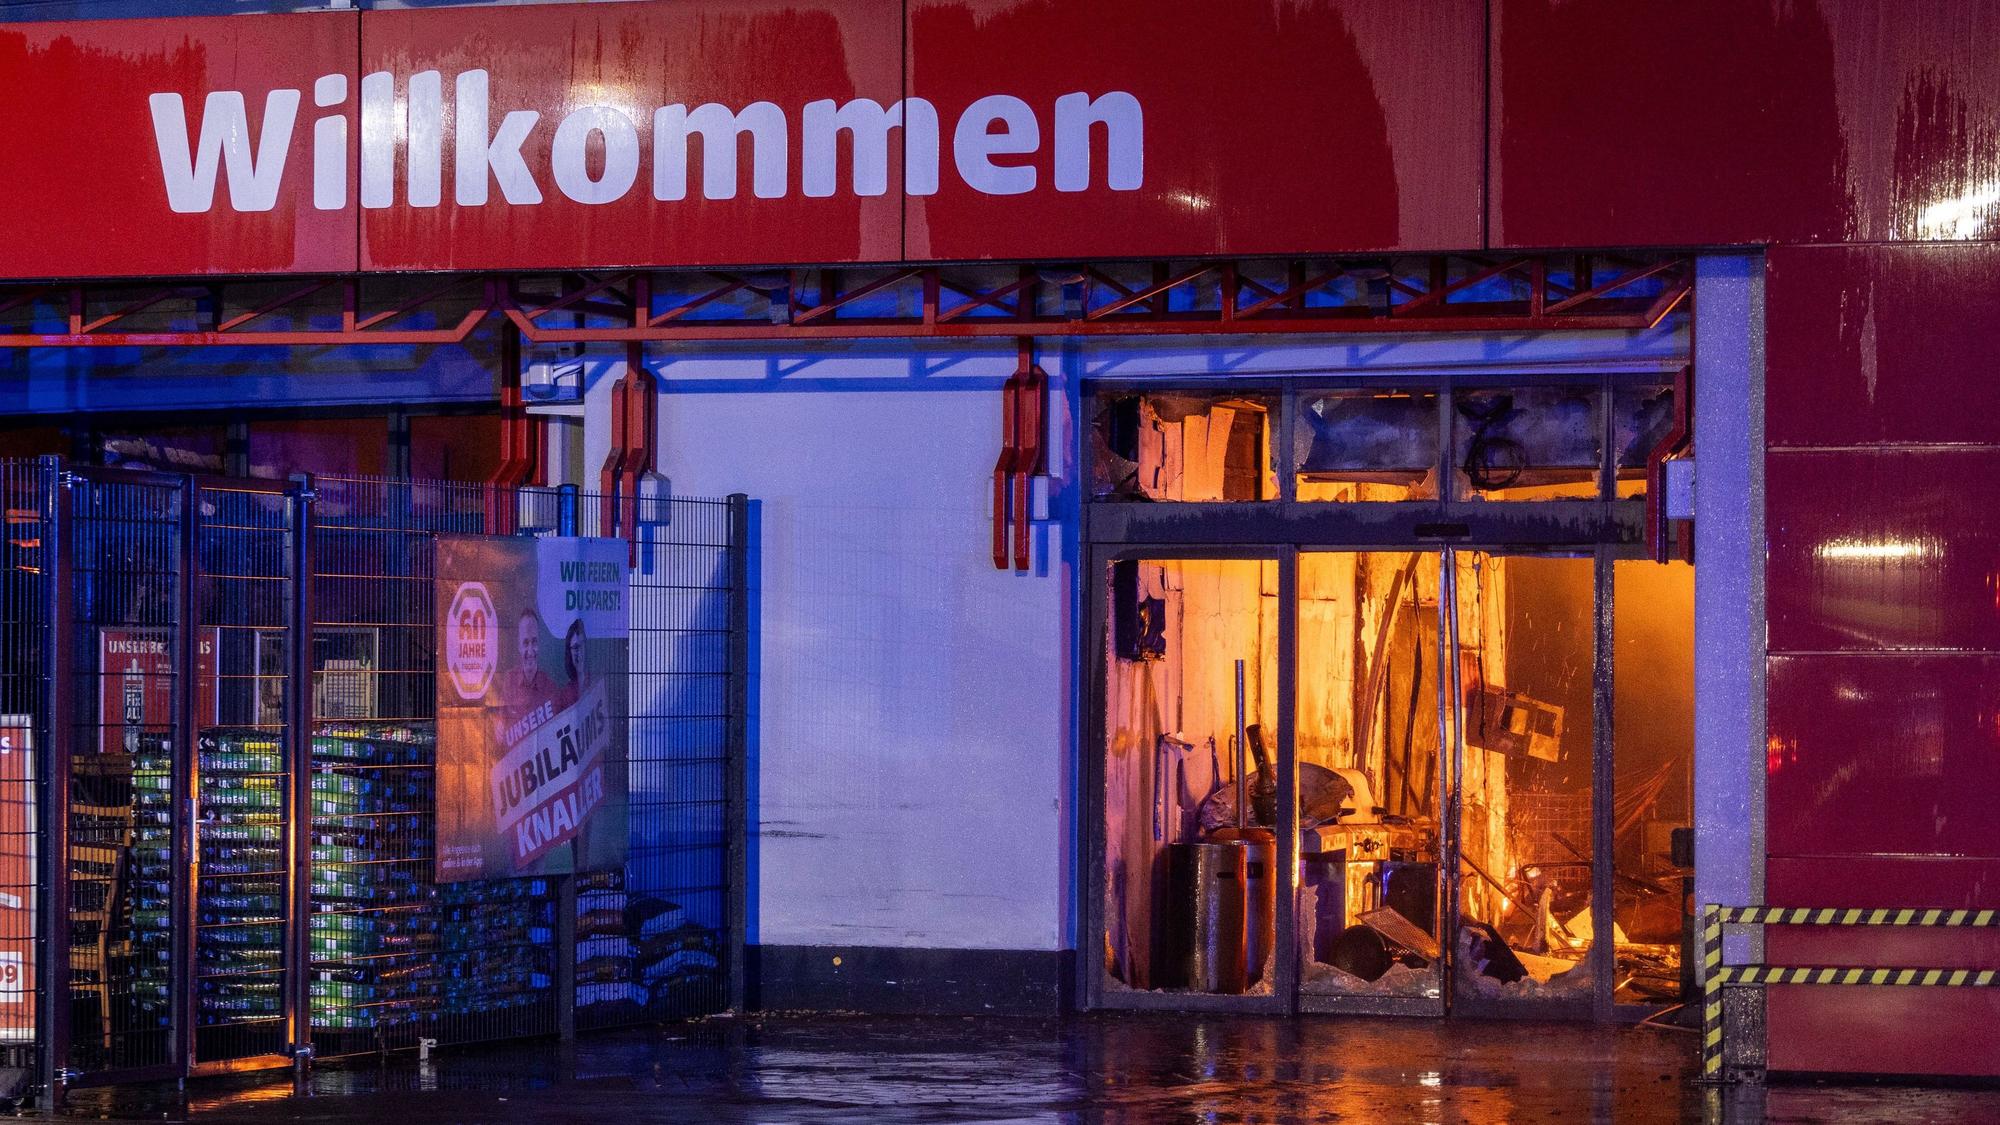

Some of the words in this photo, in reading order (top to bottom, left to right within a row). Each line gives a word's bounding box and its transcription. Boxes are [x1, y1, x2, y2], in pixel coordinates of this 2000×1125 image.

[149, 68, 1145, 214] Willkommen
[560, 561, 586, 582] WIR
[588, 562, 622, 584] FEIERN,
[566, 590, 584, 611] DU
[586, 590, 621, 611] SPARST!
[459, 609, 486, 640] 60
[458, 643, 486, 659] JAHRE
[506, 700, 554, 747] UNSERE
[499, 699, 605, 818] JUBILÄUMS
[515, 767, 604, 858] KNALLER
[0, 964, 17, 984] 9
